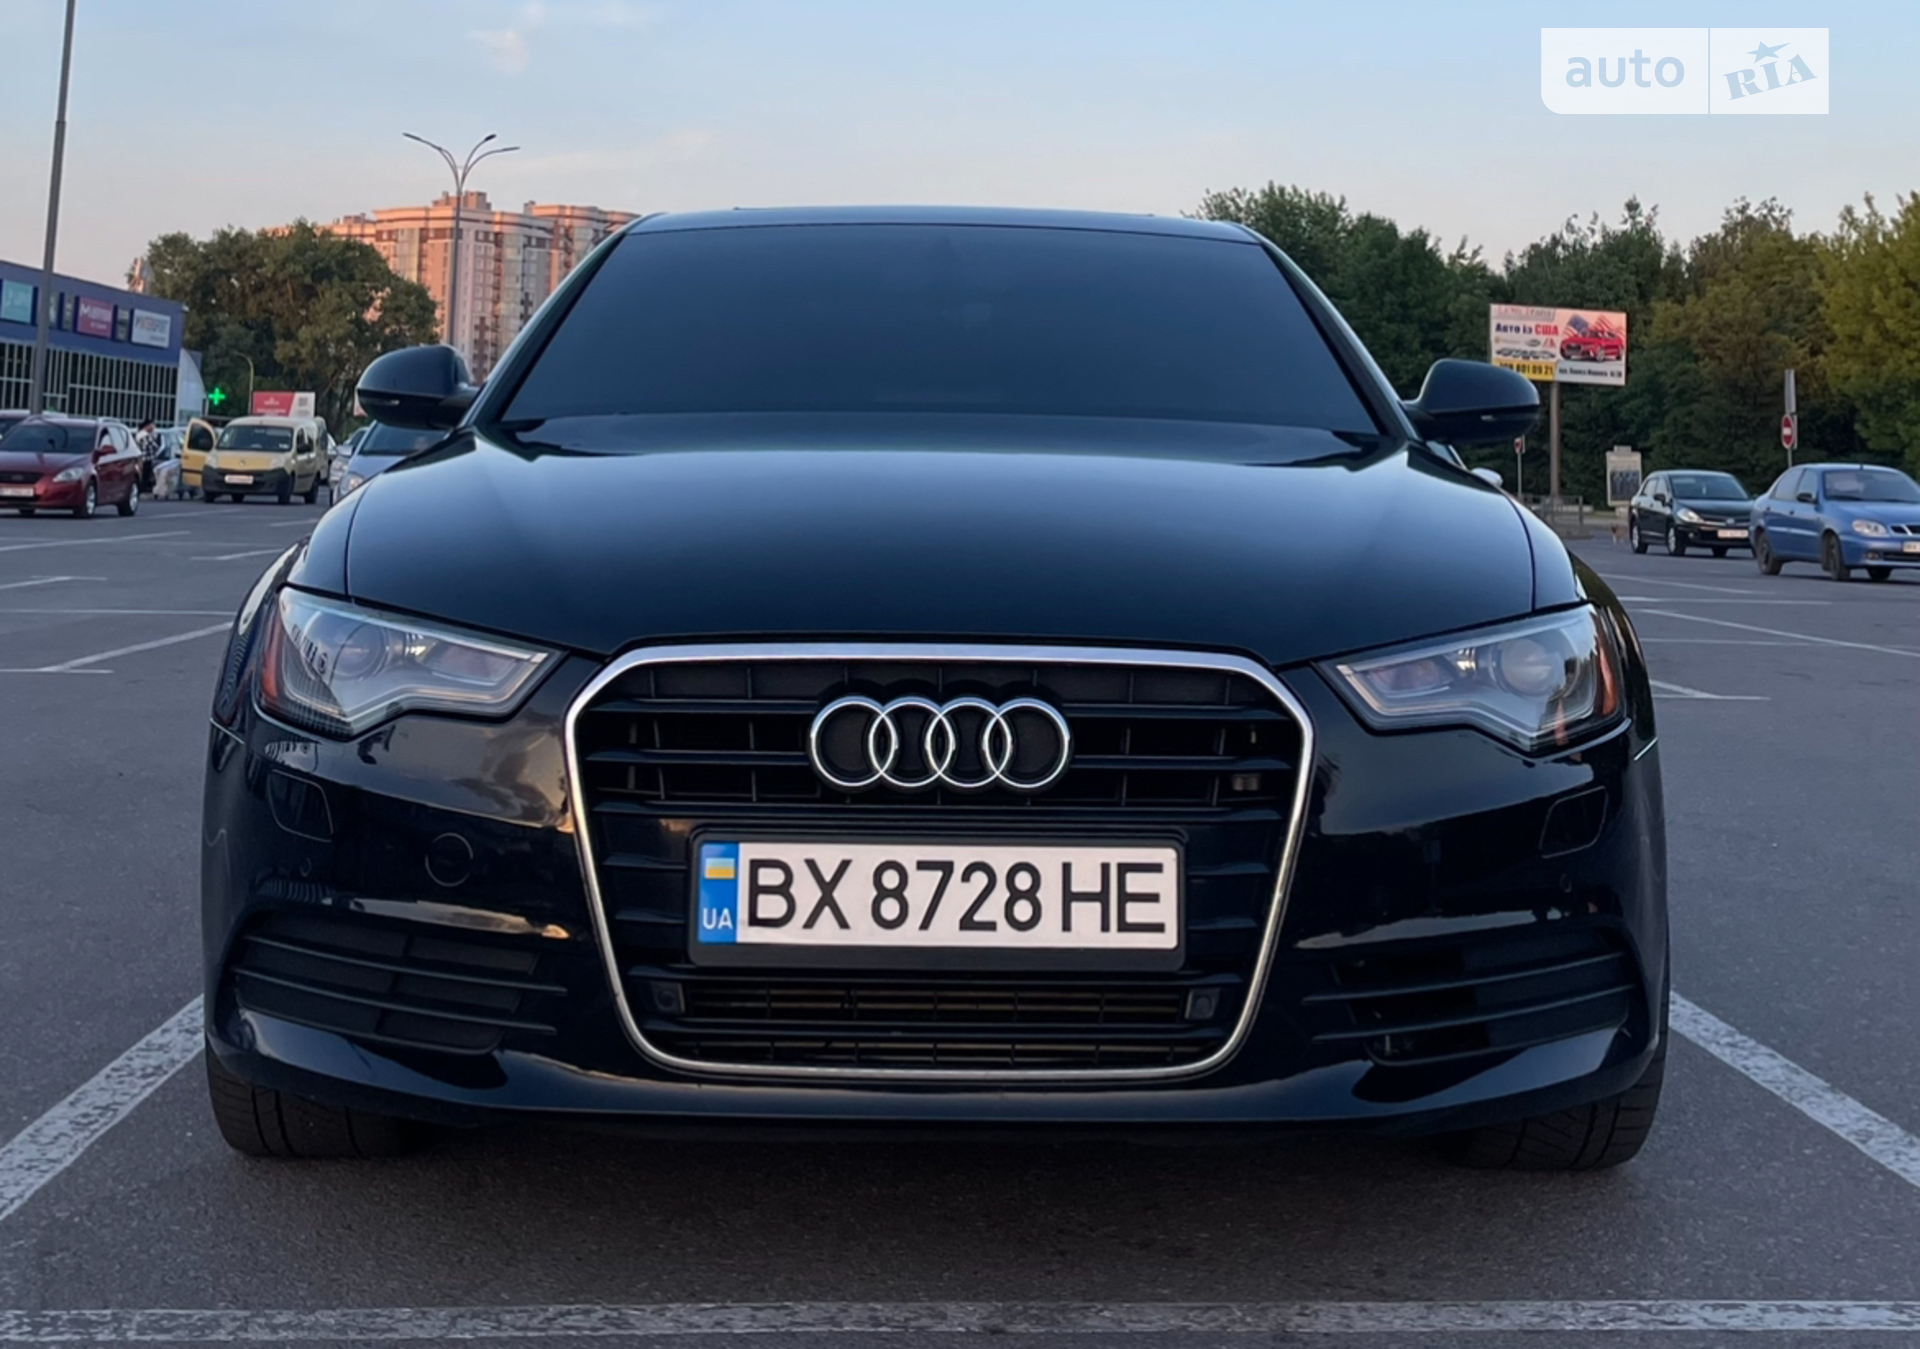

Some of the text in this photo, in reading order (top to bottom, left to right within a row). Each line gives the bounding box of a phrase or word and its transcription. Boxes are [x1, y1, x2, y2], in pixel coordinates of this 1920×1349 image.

[1495, 323, 1521, 334] Авто
[1535, 324, 1560, 336] США
[747, 858, 1166, 933] BX 8728 HE
[702, 907, 734, 930] UA
